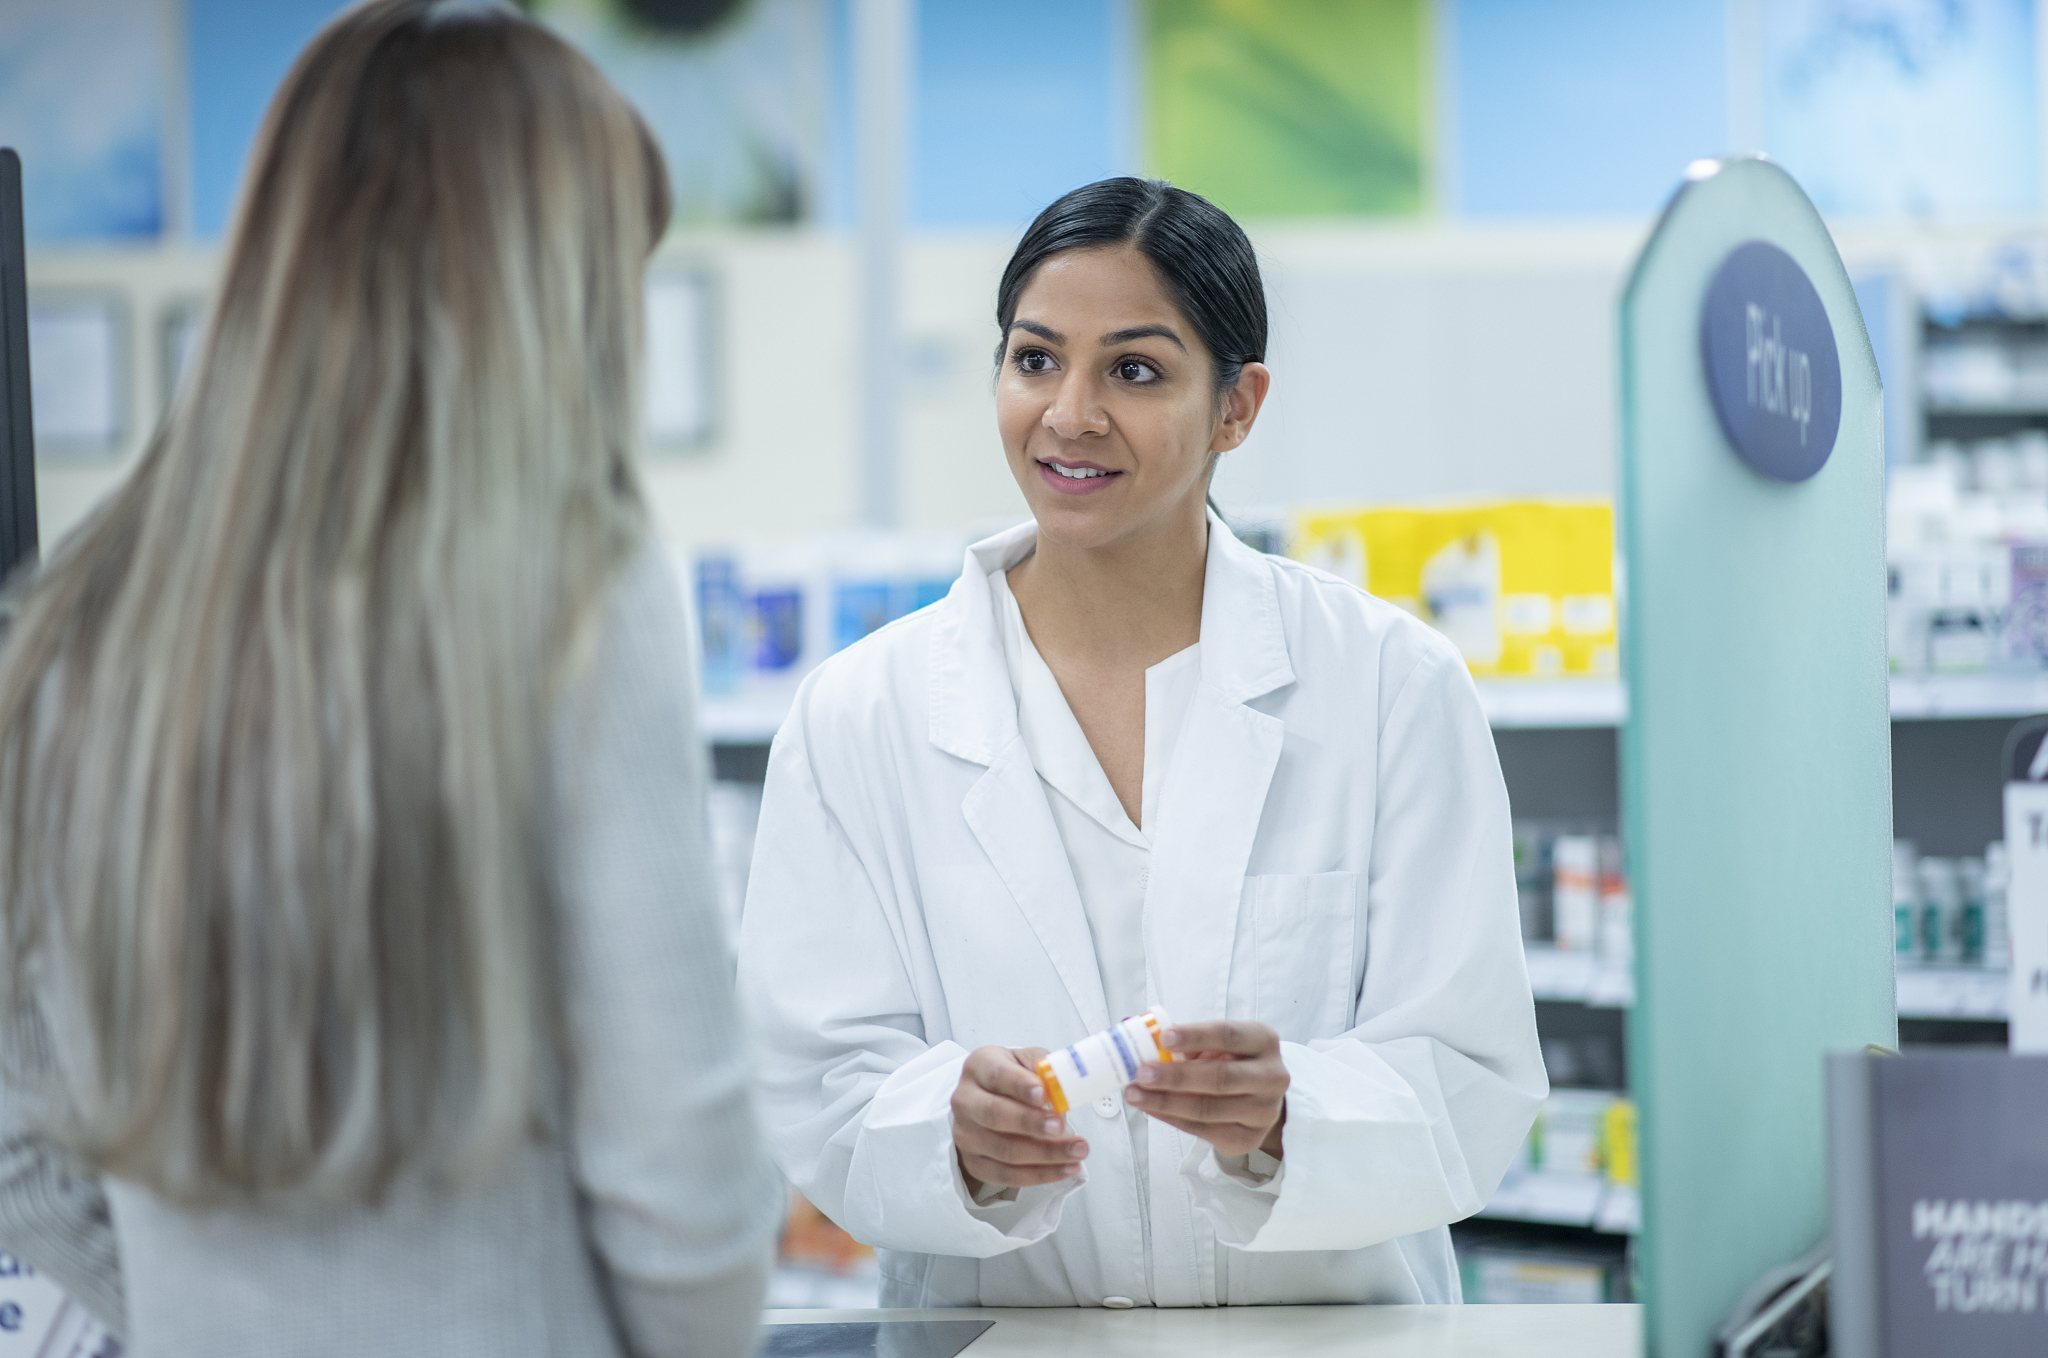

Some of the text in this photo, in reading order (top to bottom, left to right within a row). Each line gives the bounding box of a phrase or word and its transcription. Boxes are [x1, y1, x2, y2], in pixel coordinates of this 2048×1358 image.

[1746, 302, 1812, 447] Pick up
[1927, 1277, 2037, 1313] TURN
